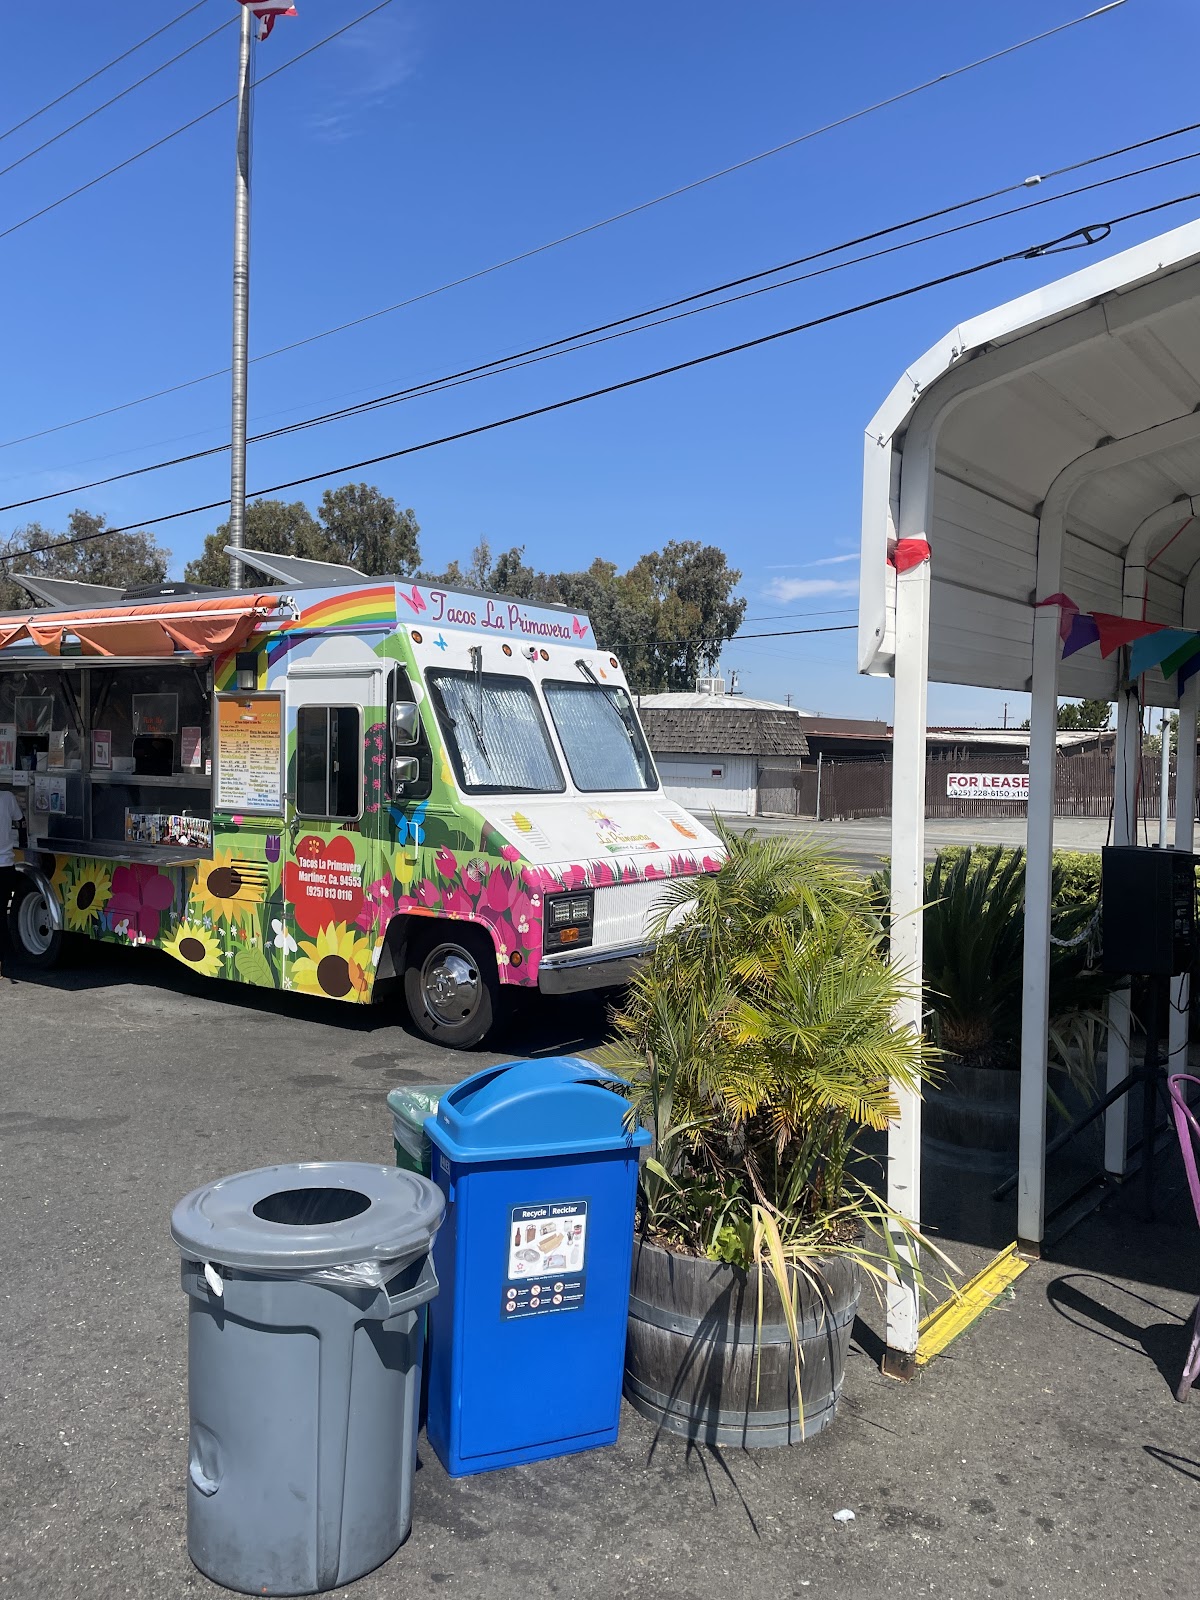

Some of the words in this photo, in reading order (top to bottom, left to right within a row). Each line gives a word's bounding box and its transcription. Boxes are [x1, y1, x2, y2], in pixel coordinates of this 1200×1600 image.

[430, 591, 477, 626] Tacos
[481, 600, 505, 630] La
[508, 604, 572, 640] Primavera
[949, 777, 978, 787] FOR
[983, 777, 1029, 788] LEASE
[950, 789, 971, 797] (925)
[299, 857, 318, 869] Tacos
[319, 859, 326, 870] La
[327, 860, 361, 873] Primavera
[299, 871, 328, 884] Martinez,
[329, 874, 339, 885] Ca.
[340, 875, 361, 887] 94553
[306, 886, 324, 898] (925)
[325, 888, 337, 899] 813
[337, 889, 353, 901] 0116
[522, 1208, 547, 1219] Recycle
[552, 1205, 578, 1215] Reciclar
